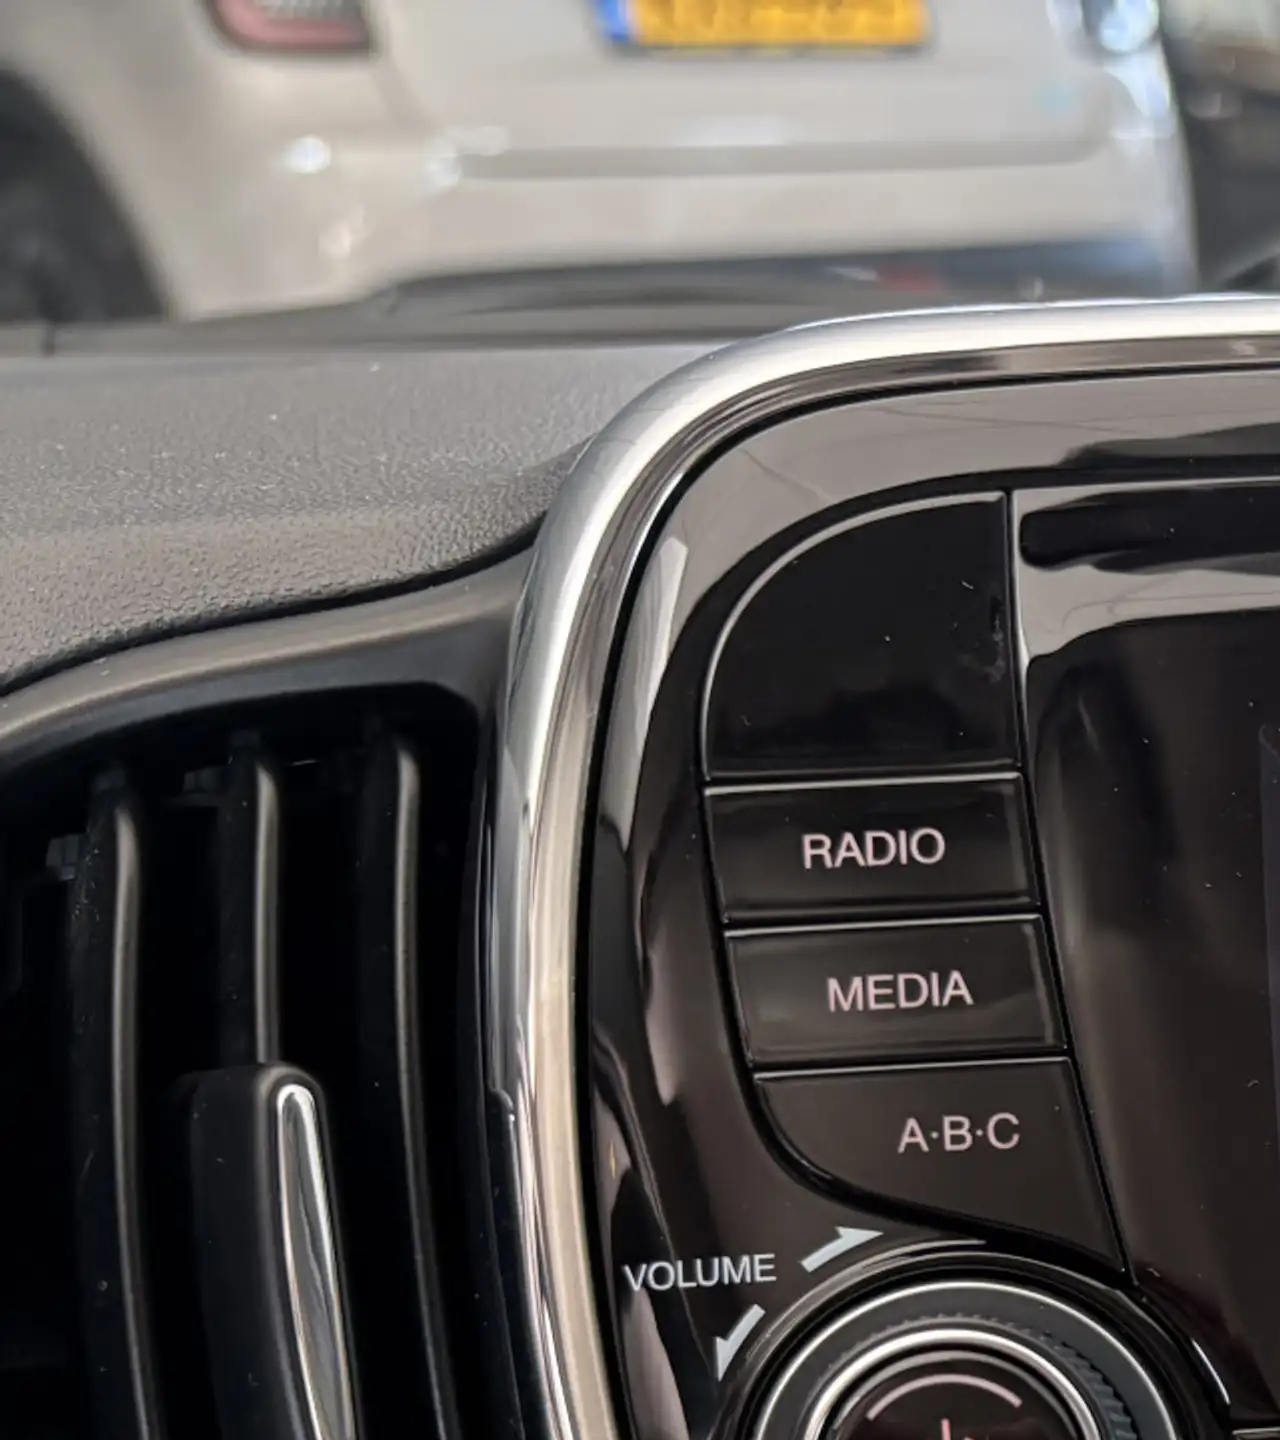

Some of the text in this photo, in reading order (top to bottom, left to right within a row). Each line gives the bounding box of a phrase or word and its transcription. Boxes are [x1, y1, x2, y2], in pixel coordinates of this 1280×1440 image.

[803, 827, 945, 869] RADIO
[827, 970, 973, 1012] MEDIA
[624, 1253, 777, 1292] VOLUME
